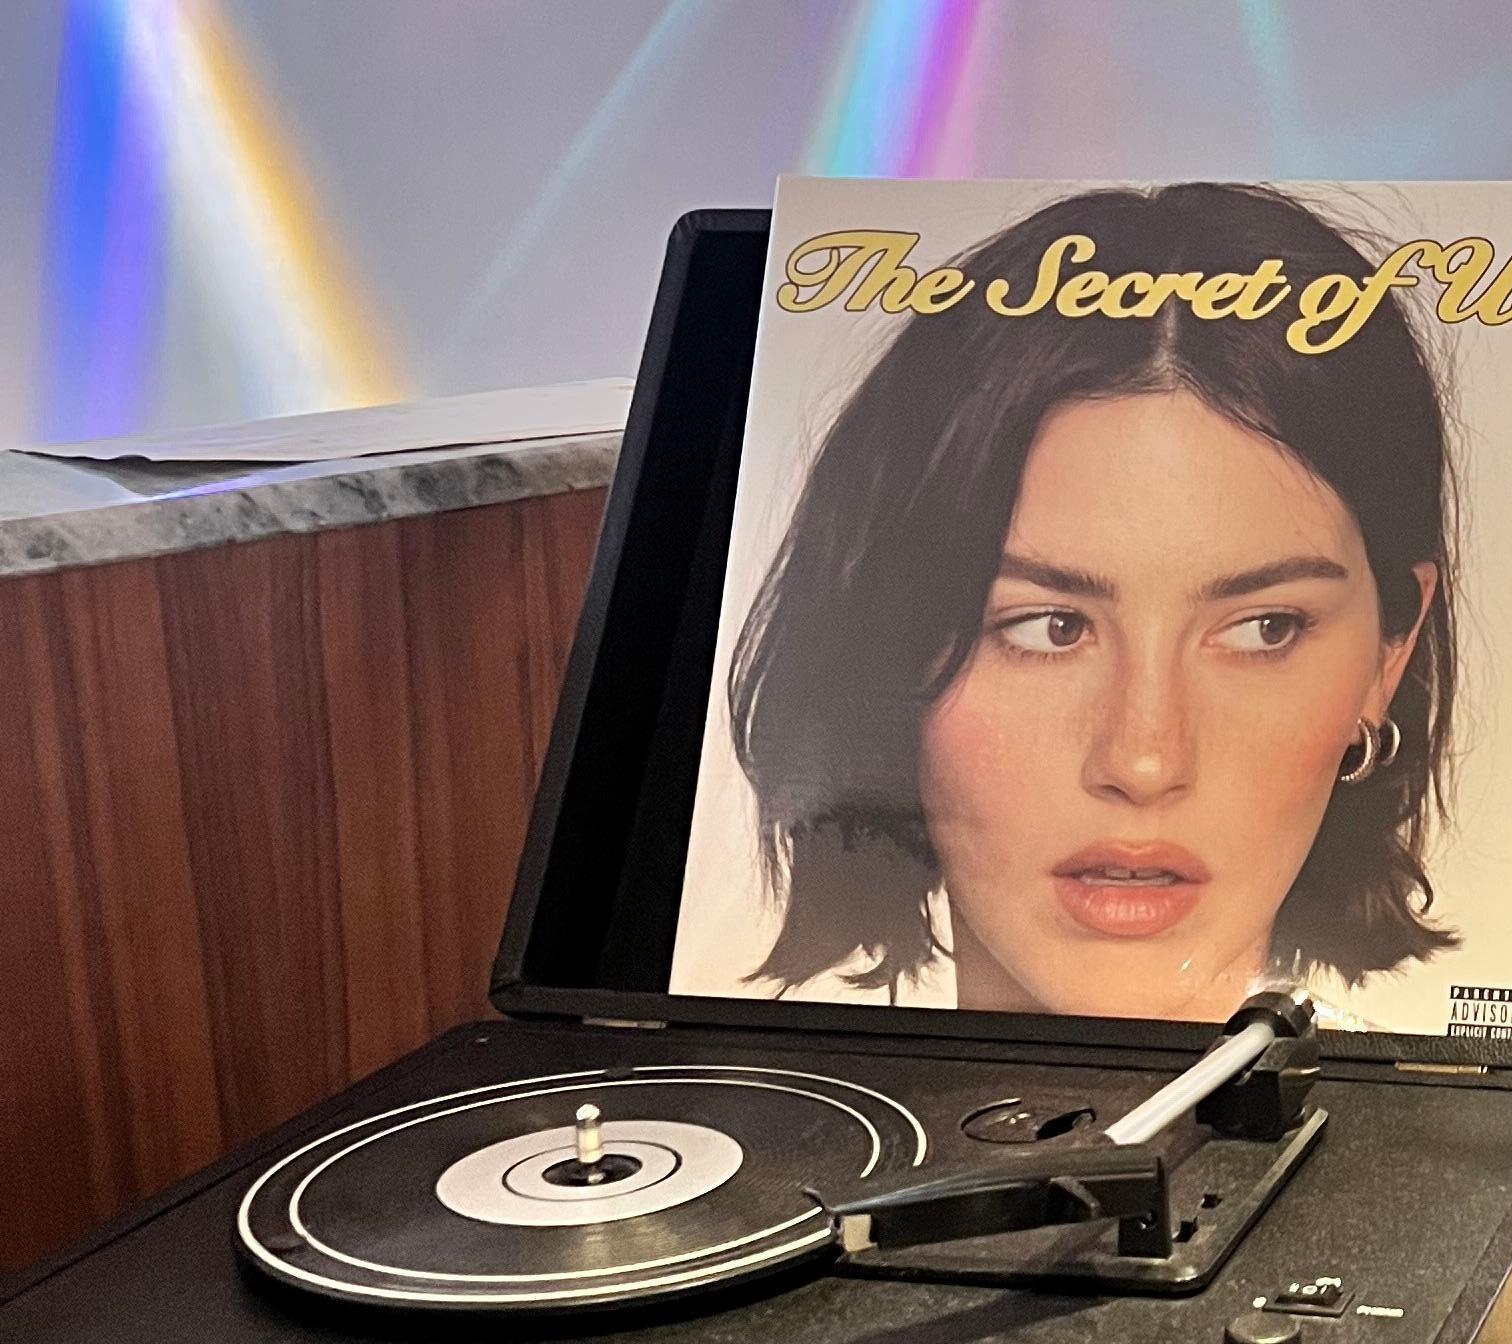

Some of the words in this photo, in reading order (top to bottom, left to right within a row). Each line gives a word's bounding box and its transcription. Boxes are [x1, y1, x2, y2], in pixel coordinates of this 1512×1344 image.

[777, 228, 974, 315] The
[985, 234, 1291, 321] Secret
[1285, 240, 1439, 355] of
